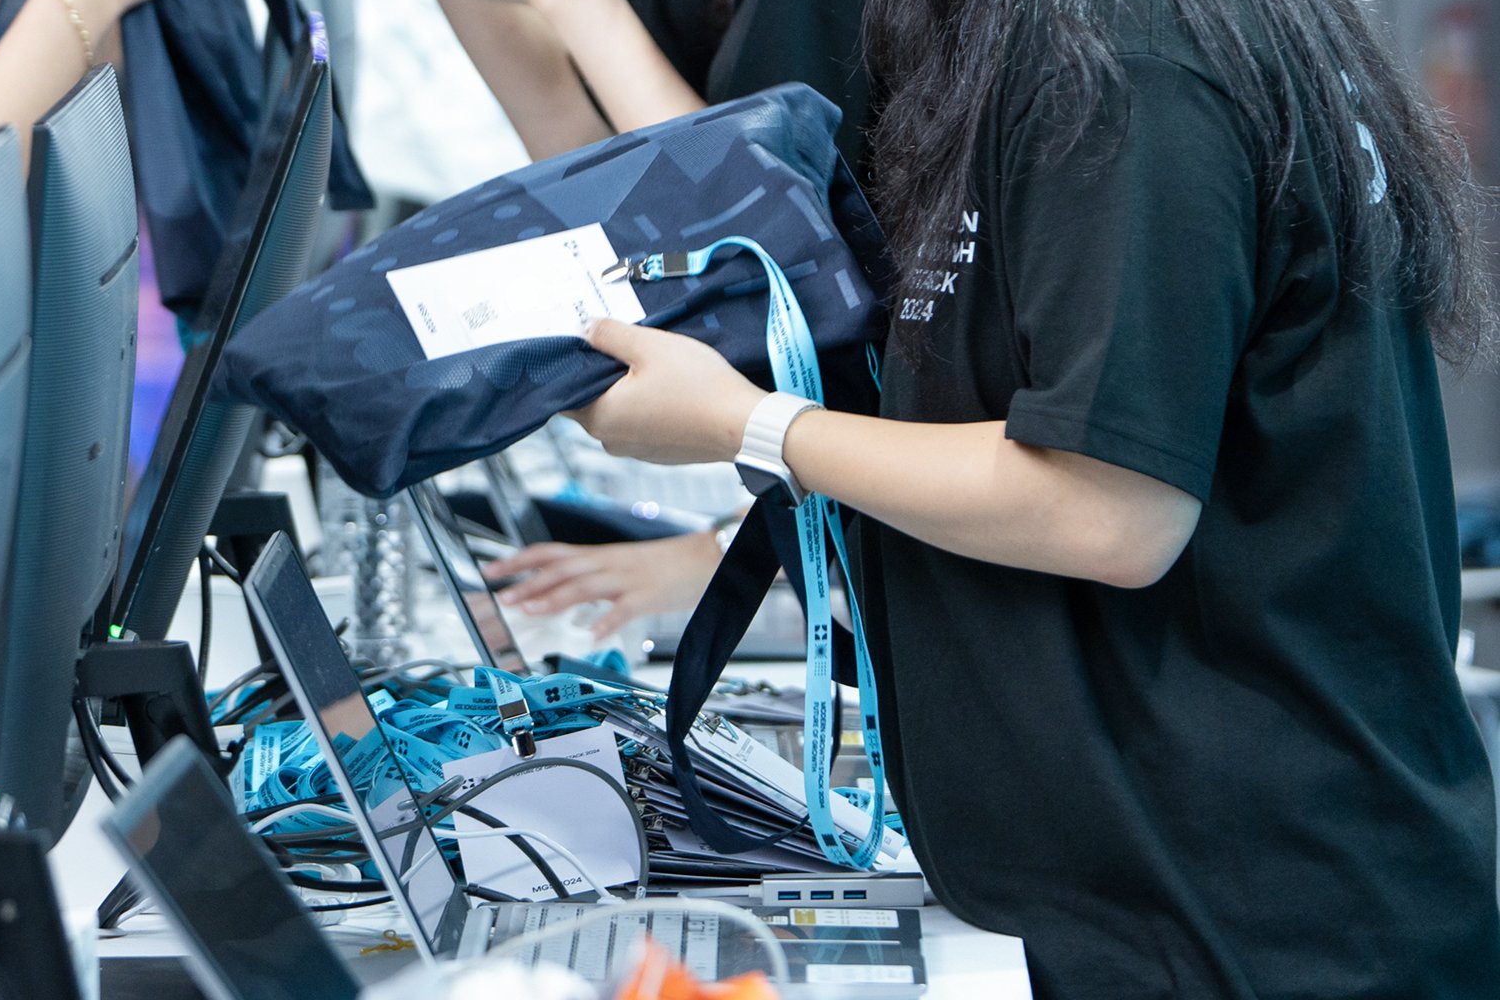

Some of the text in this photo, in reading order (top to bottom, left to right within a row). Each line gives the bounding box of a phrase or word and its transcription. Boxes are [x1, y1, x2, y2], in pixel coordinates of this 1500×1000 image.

[806, 530, 815, 562] GROWTH
[813, 523, 821, 555] GROWTH
[815, 556, 823, 578] STACK
[817, 580, 825, 598] 2024
[585, 748, 600, 757] 2024
